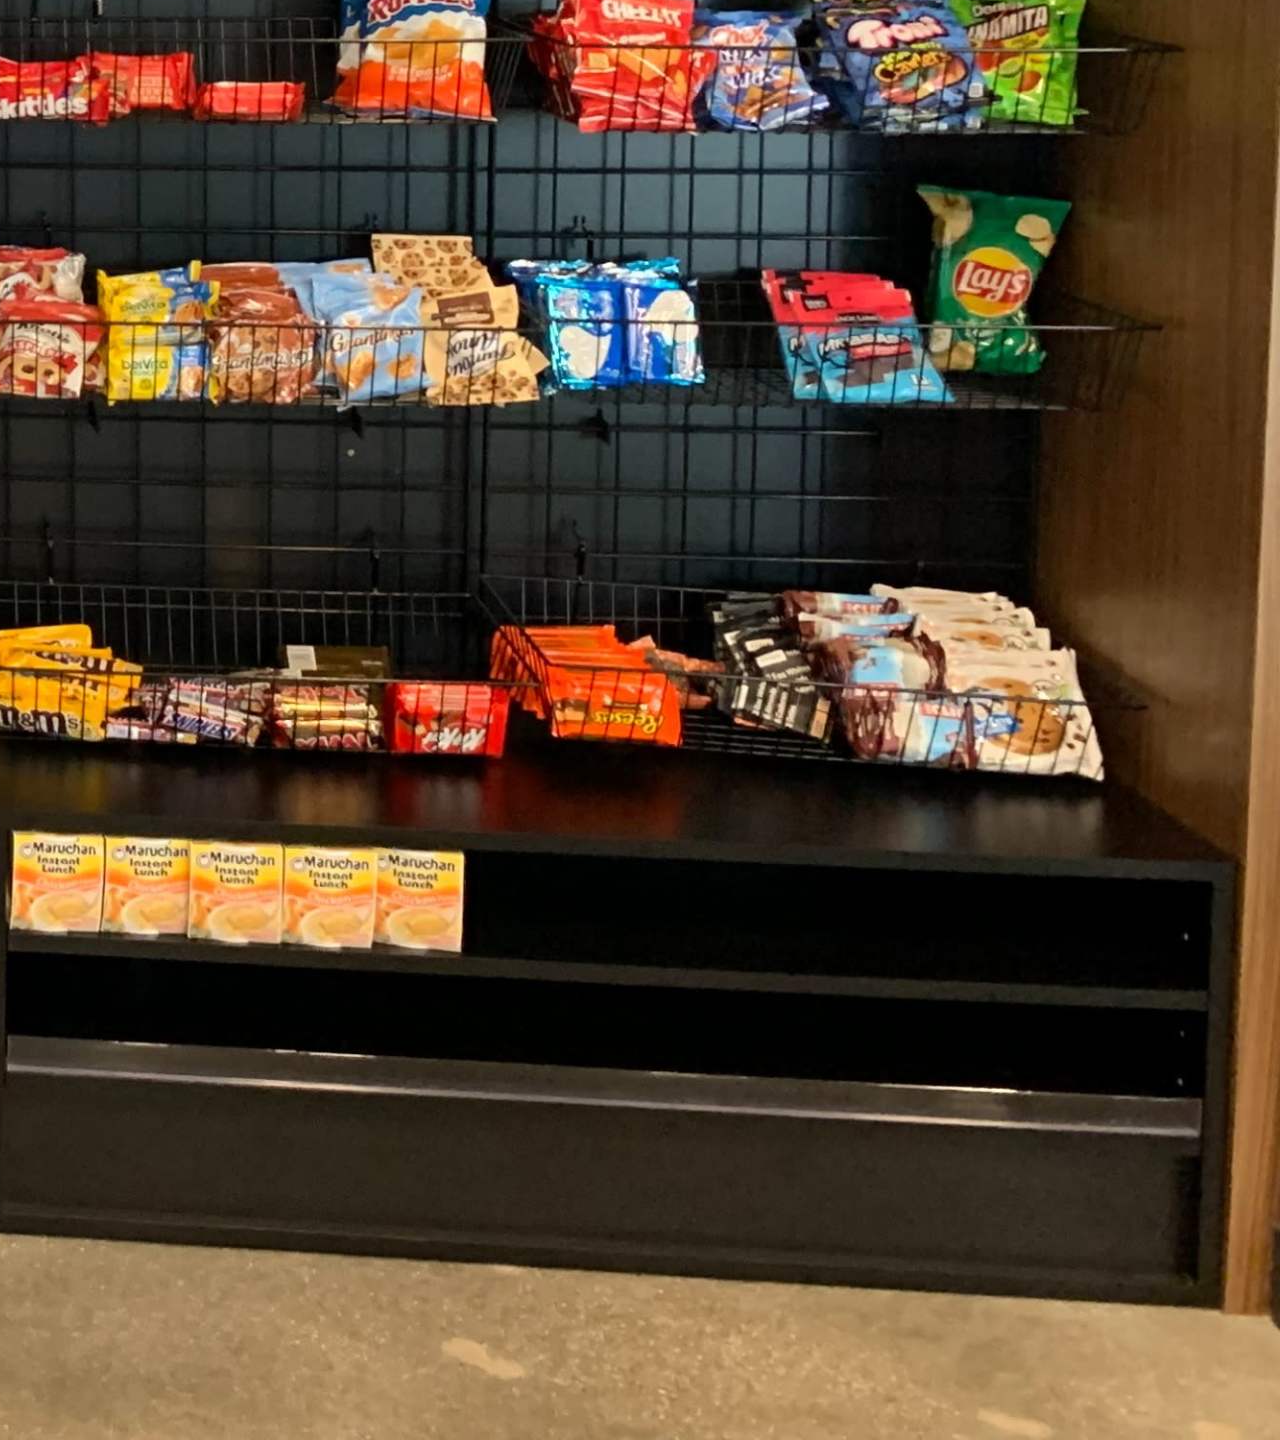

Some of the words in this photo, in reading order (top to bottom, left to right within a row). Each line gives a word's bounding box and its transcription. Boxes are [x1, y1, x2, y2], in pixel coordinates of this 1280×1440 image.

[957, 262, 1029, 302] Lay's
[33, 842, 96, 856] Maruchan
[125, 844, 188, 858] Maruchan
[37, 856, 81, 866] Instant
[129, 858, 173, 869] Instant
[209, 851, 276, 868] Maruchan
[304, 856, 370, 871] Maruchan
[388, 854, 456, 873] Maruchan
[42, 865, 76, 875] Lunch
[134, 868, 168, 878] Lunch
[214, 865, 260, 878] Instant
[308, 869, 353, 881] Instant
[392, 868, 439, 882] Instant
[219, 875, 255, 886] Lunch
[313, 879, 349, 890] Lunch
[397, 878, 434, 890] Lunch
